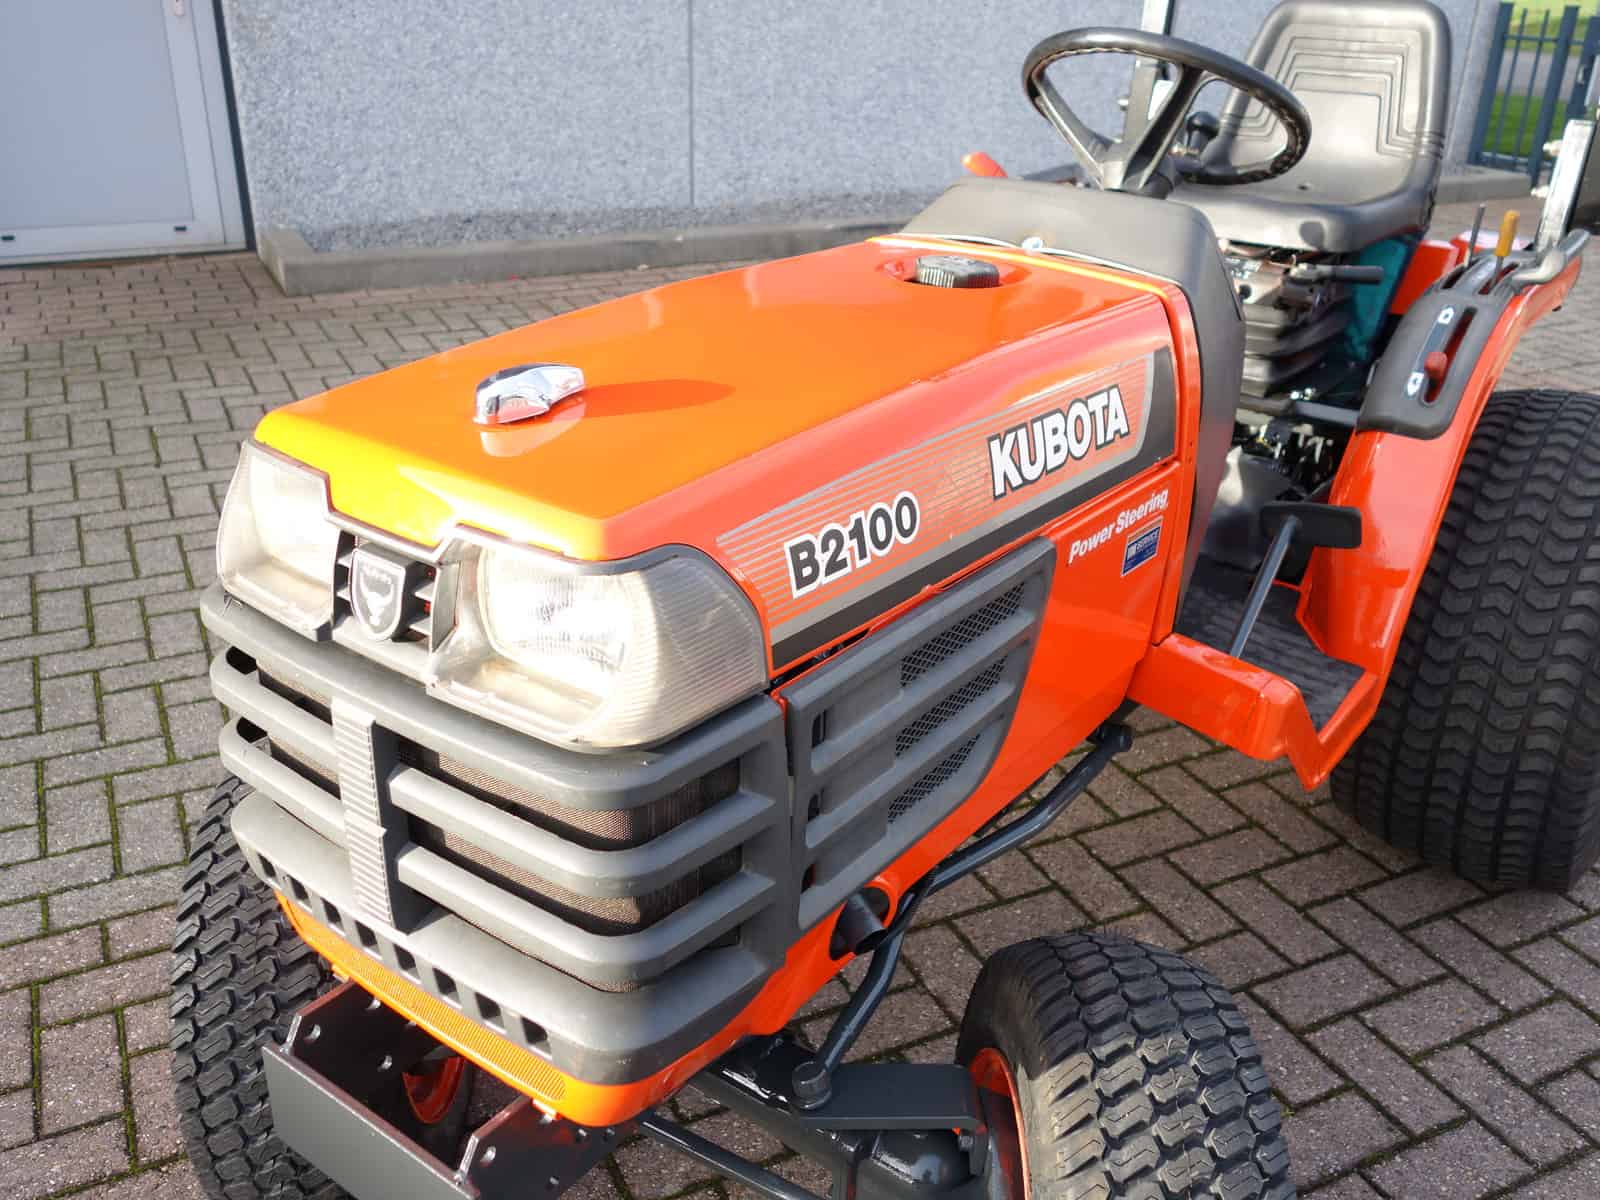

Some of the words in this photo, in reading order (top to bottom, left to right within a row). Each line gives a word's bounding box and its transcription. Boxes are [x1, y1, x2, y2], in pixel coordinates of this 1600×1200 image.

[988, 385, 1129, 498] KUBOTA
[785, 491, 919, 597] B2100
[1068, 522, 1115, 565] Power
[1115, 489, 1168, 533] Steering
